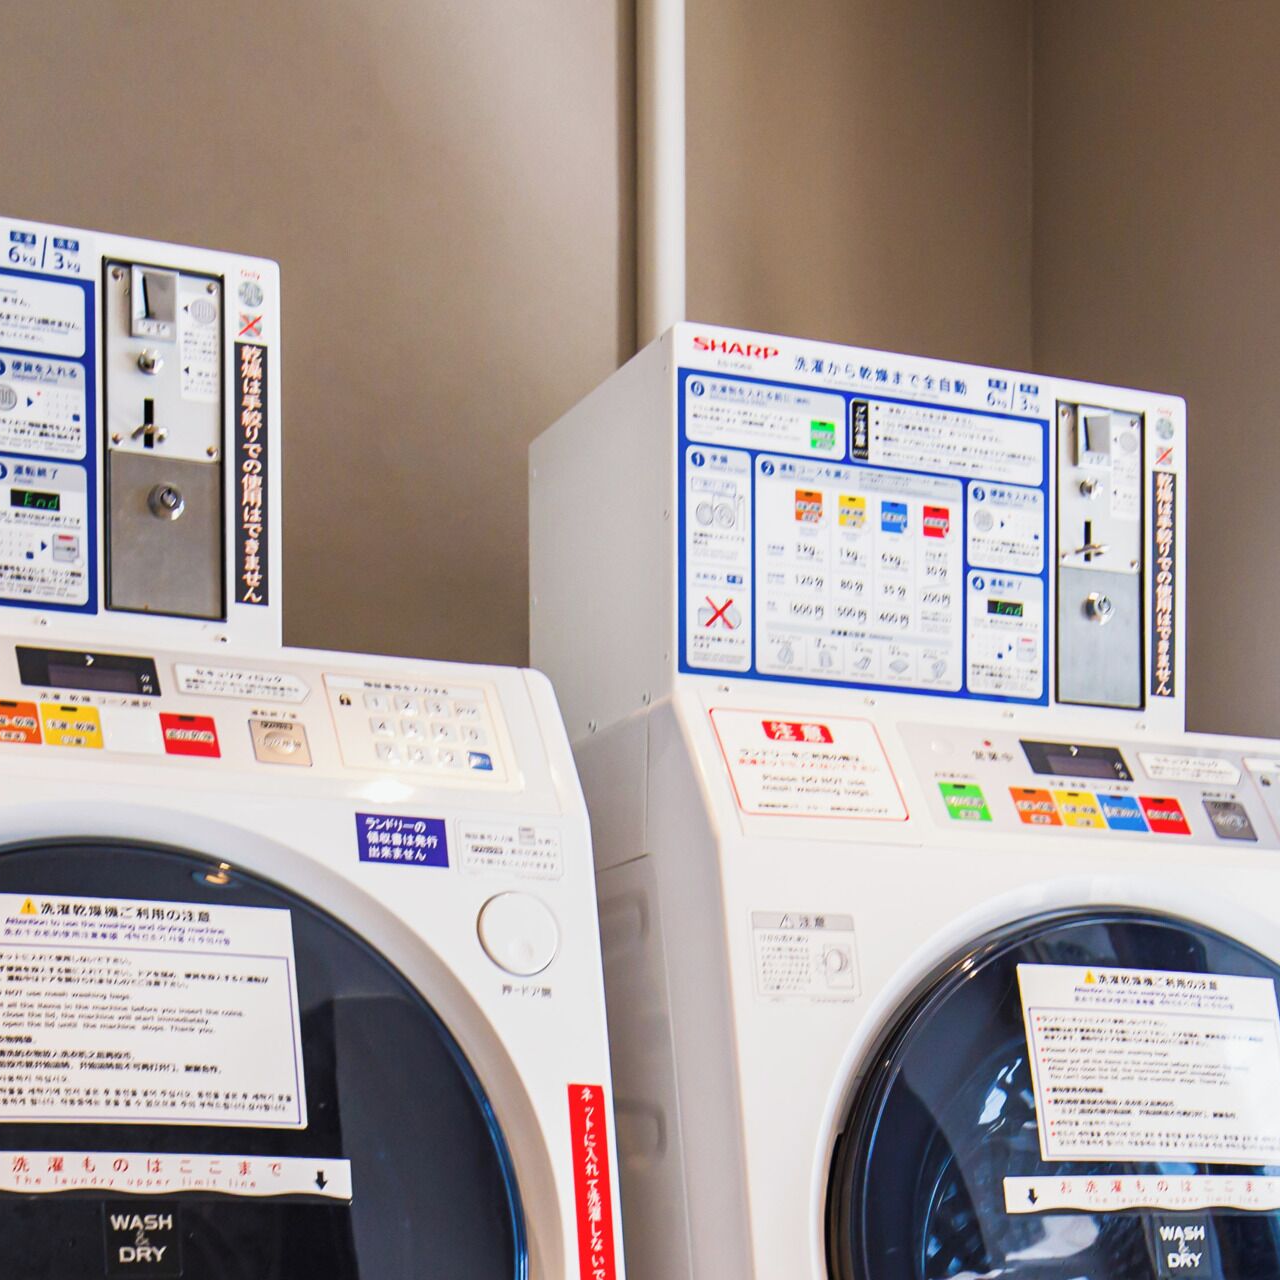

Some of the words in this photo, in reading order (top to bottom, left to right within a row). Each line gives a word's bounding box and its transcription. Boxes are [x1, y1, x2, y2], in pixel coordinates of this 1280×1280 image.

[693, 336, 779, 360] SHARP
[770, 722, 827, 743] 注意
[365, 816, 426, 833] ランドリーの
[41, 902, 211, 923] 洗濯乾燥機ご利用の注意
[110, 1214, 173, 1232] WASH
[136, 1231, 151, 1247] &
[1159, 1225, 1206, 1242] WASH
[119, 1246, 168, 1264] DRY
[1167, 1252, 1203, 1269] DRY
